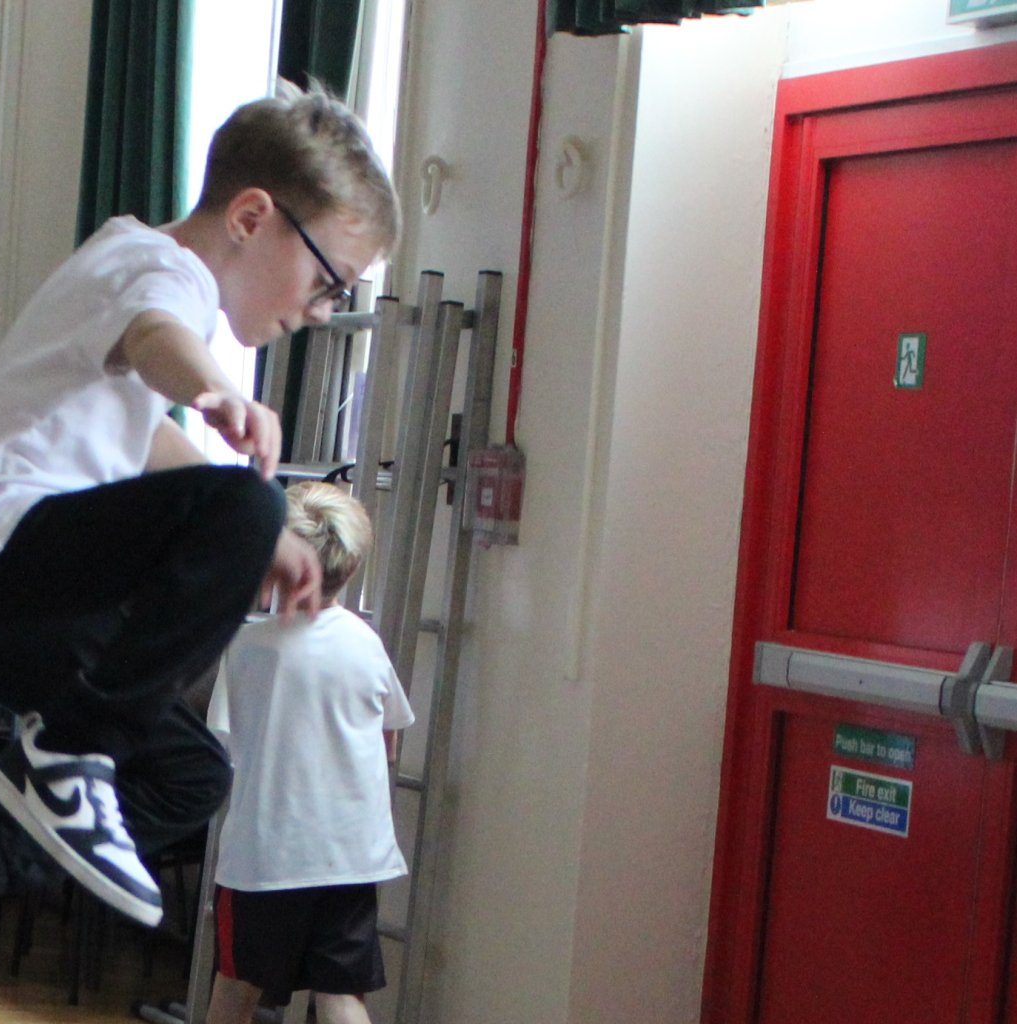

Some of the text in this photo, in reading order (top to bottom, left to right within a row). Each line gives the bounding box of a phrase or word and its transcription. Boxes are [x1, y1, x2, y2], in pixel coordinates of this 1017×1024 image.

[835, 733, 912, 763] Push bar to open
[855, 778, 897, 803] Fire exit
[848, 799, 901, 826] Keep clear
